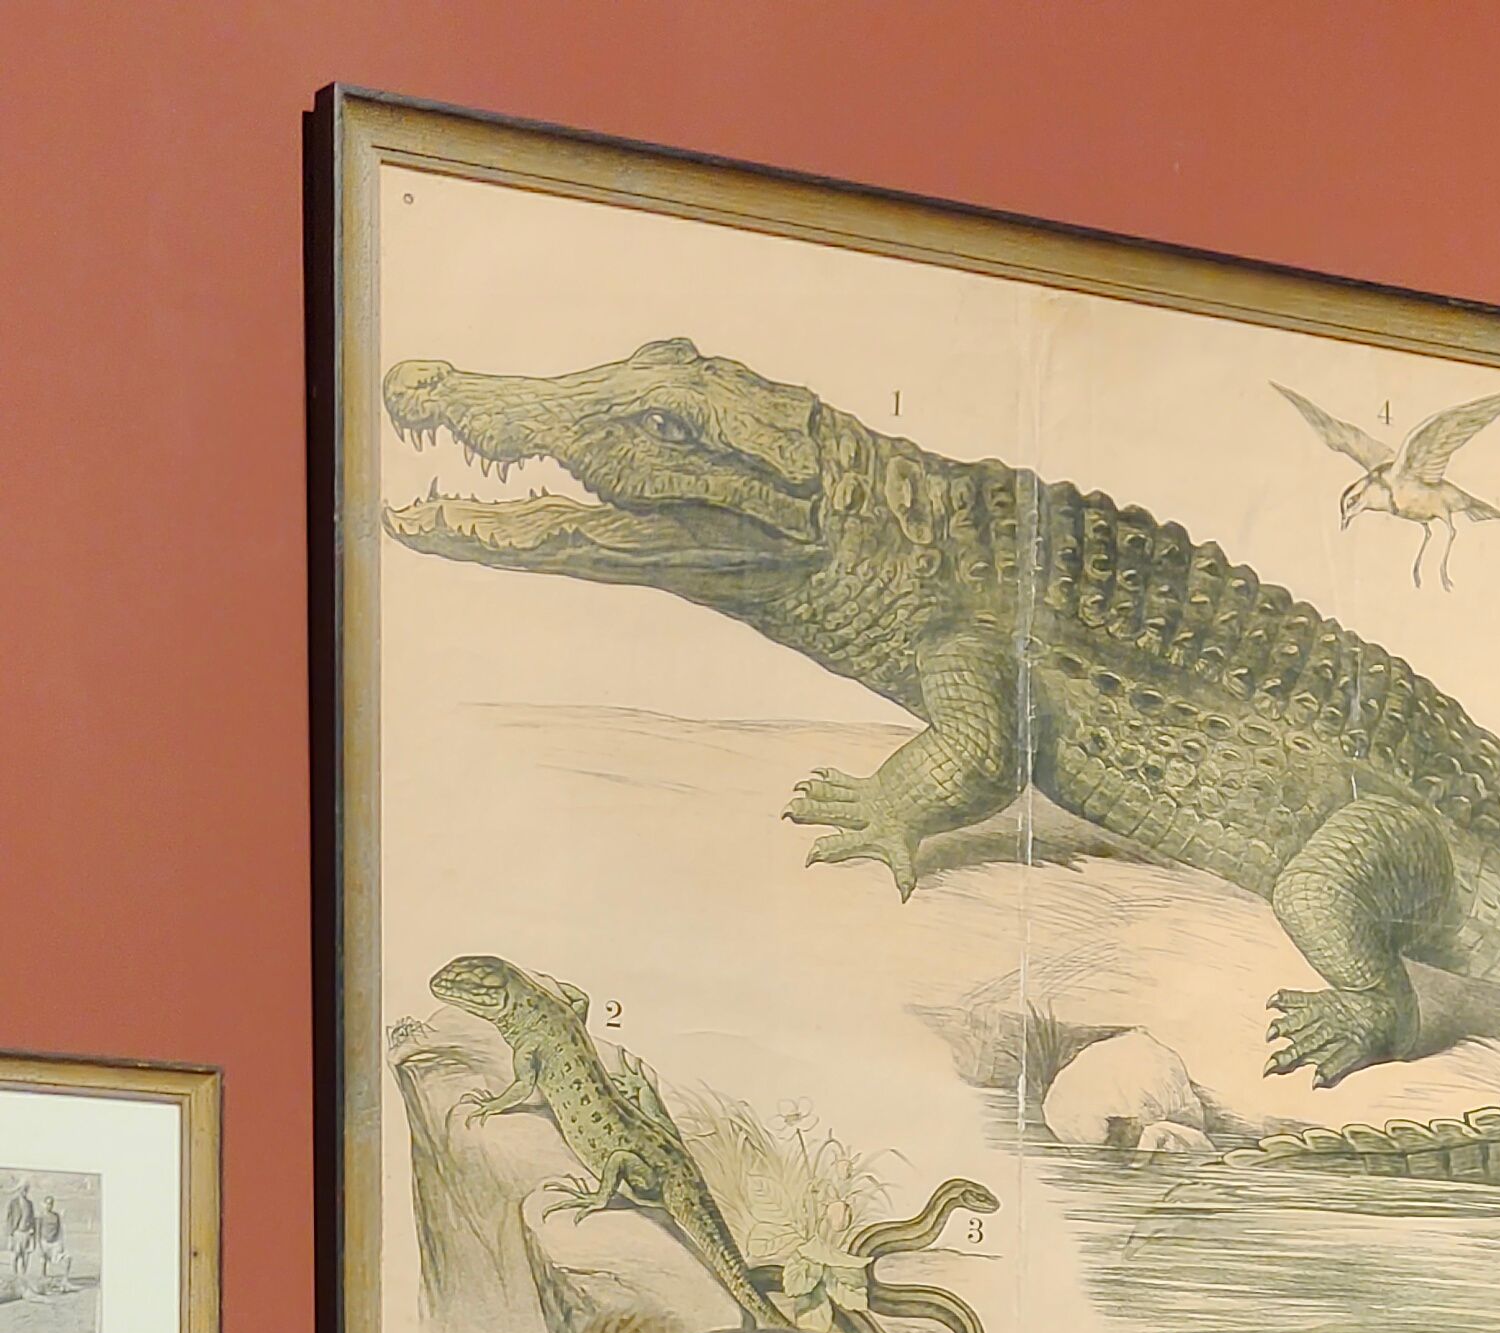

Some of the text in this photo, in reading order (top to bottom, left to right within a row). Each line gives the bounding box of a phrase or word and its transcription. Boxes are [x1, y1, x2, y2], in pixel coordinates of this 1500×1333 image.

[1377, 399, 1394, 425] 4
[605, 1000, 622, 1028] 2
[967, 1217, 983, 1244] 3
